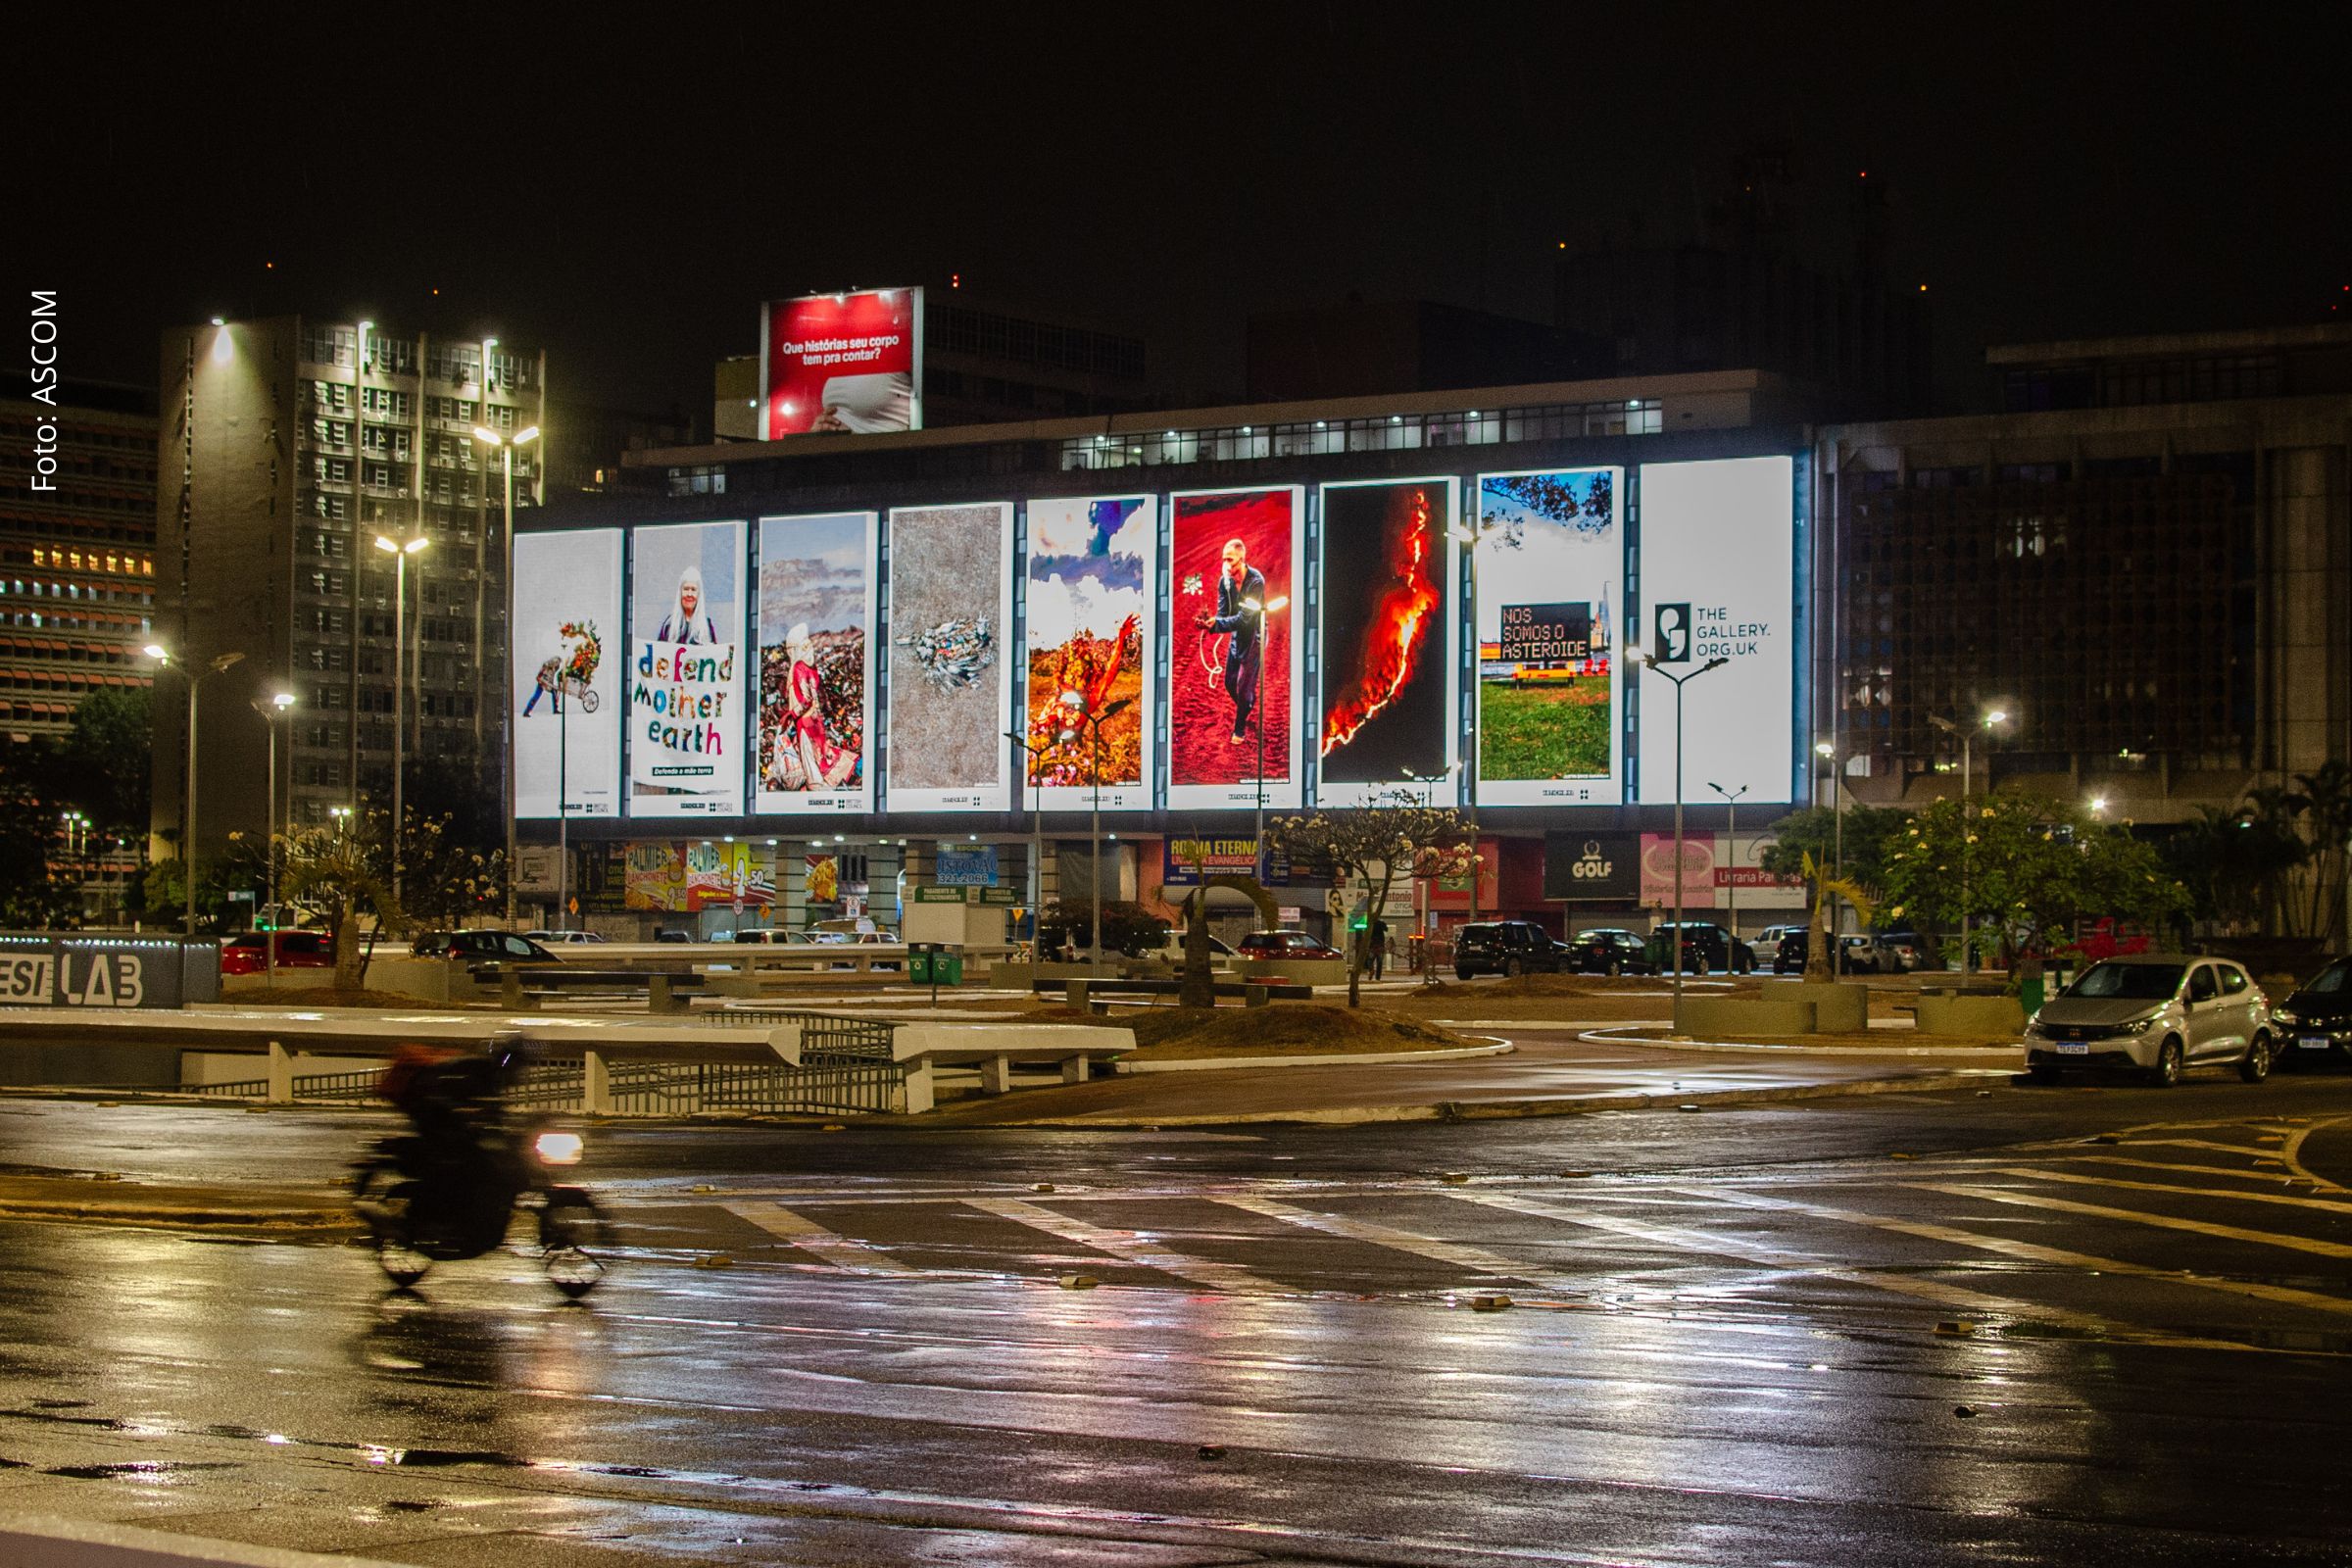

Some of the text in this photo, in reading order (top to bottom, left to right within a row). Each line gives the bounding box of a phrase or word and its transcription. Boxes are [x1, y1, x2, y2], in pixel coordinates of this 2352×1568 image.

[783, 335, 900, 355] Que histórias seu corpo
[803, 348, 881, 366] tem pra contar?
[1697, 608, 1727, 620] THE
[1503, 624, 1563, 641] SOMOS O
[1696, 624, 1771, 638] GALLERY.
[1501, 641, 1588, 660] ASTEROIDE
[1696, 643, 1758, 656] ORG.UK
[638, 643, 734, 683] defend
[648, 720, 722, 756] earth
[1572, 861, 1612, 878] GOLF
[61, 954, 143, 1007] LAB
